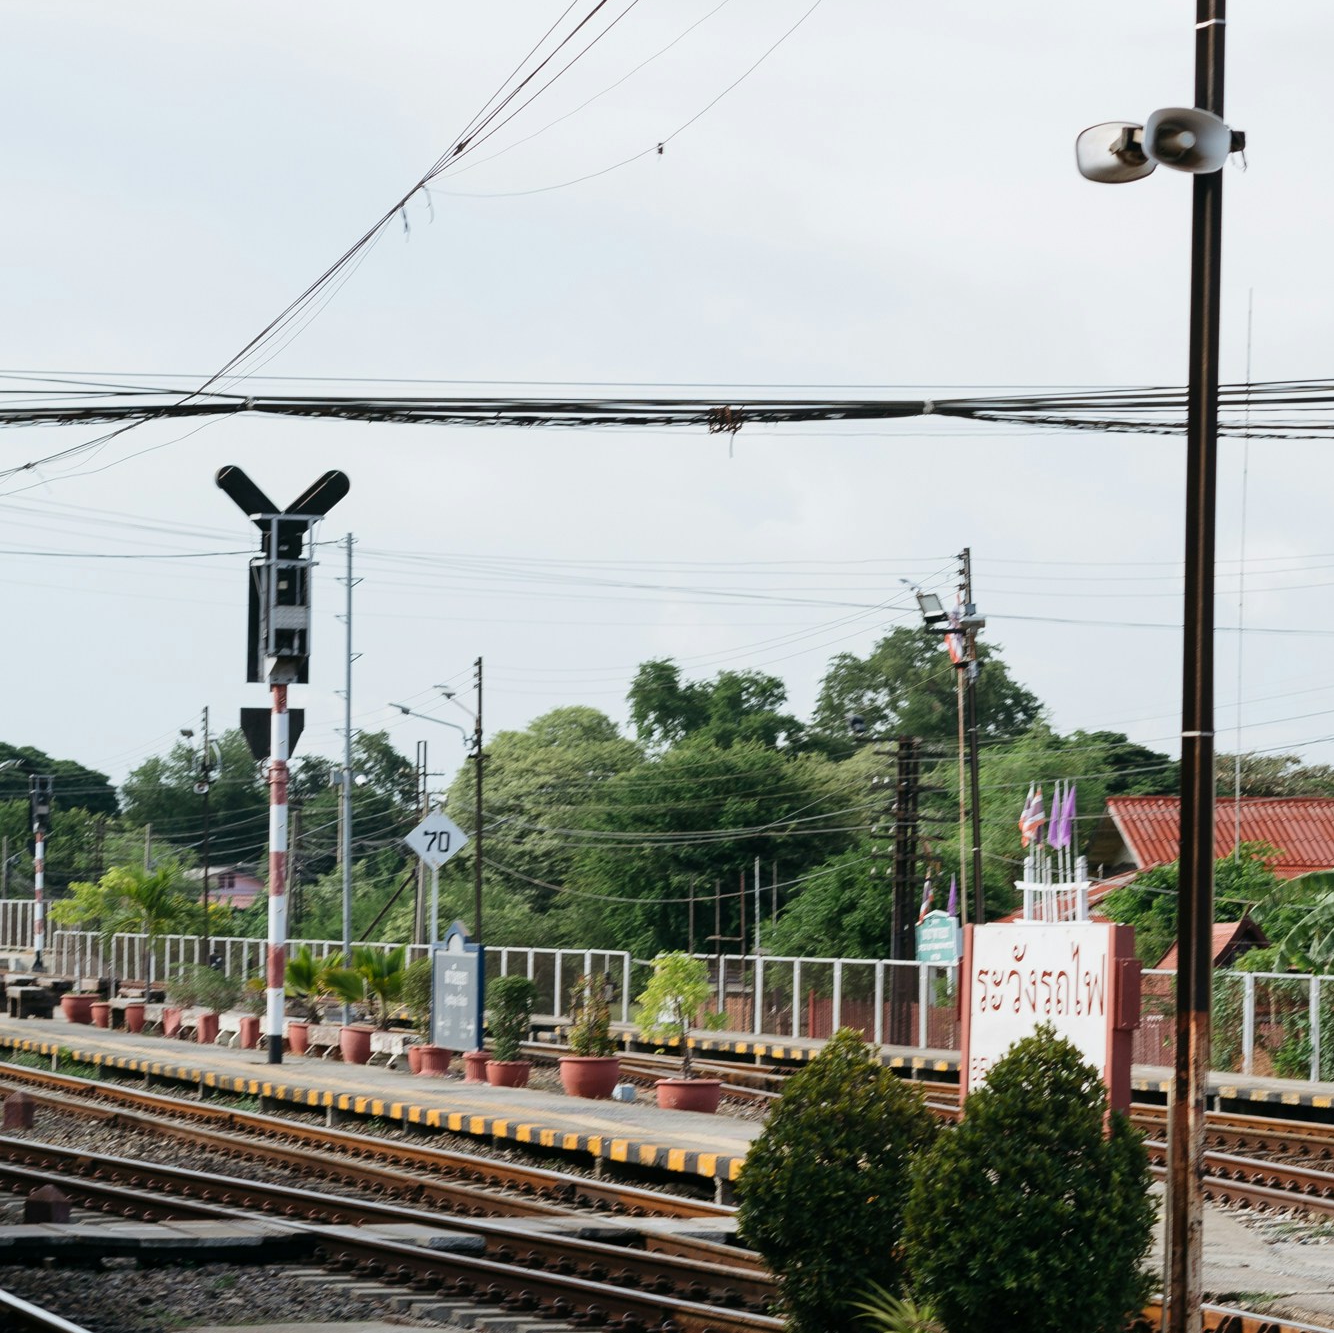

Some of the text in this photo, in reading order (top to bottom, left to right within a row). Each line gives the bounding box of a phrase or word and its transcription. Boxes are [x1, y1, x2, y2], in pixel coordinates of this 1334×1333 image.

[423, 830, 450, 853] 70
[977, 941, 1106, 1016] ระวังรถไฟ
